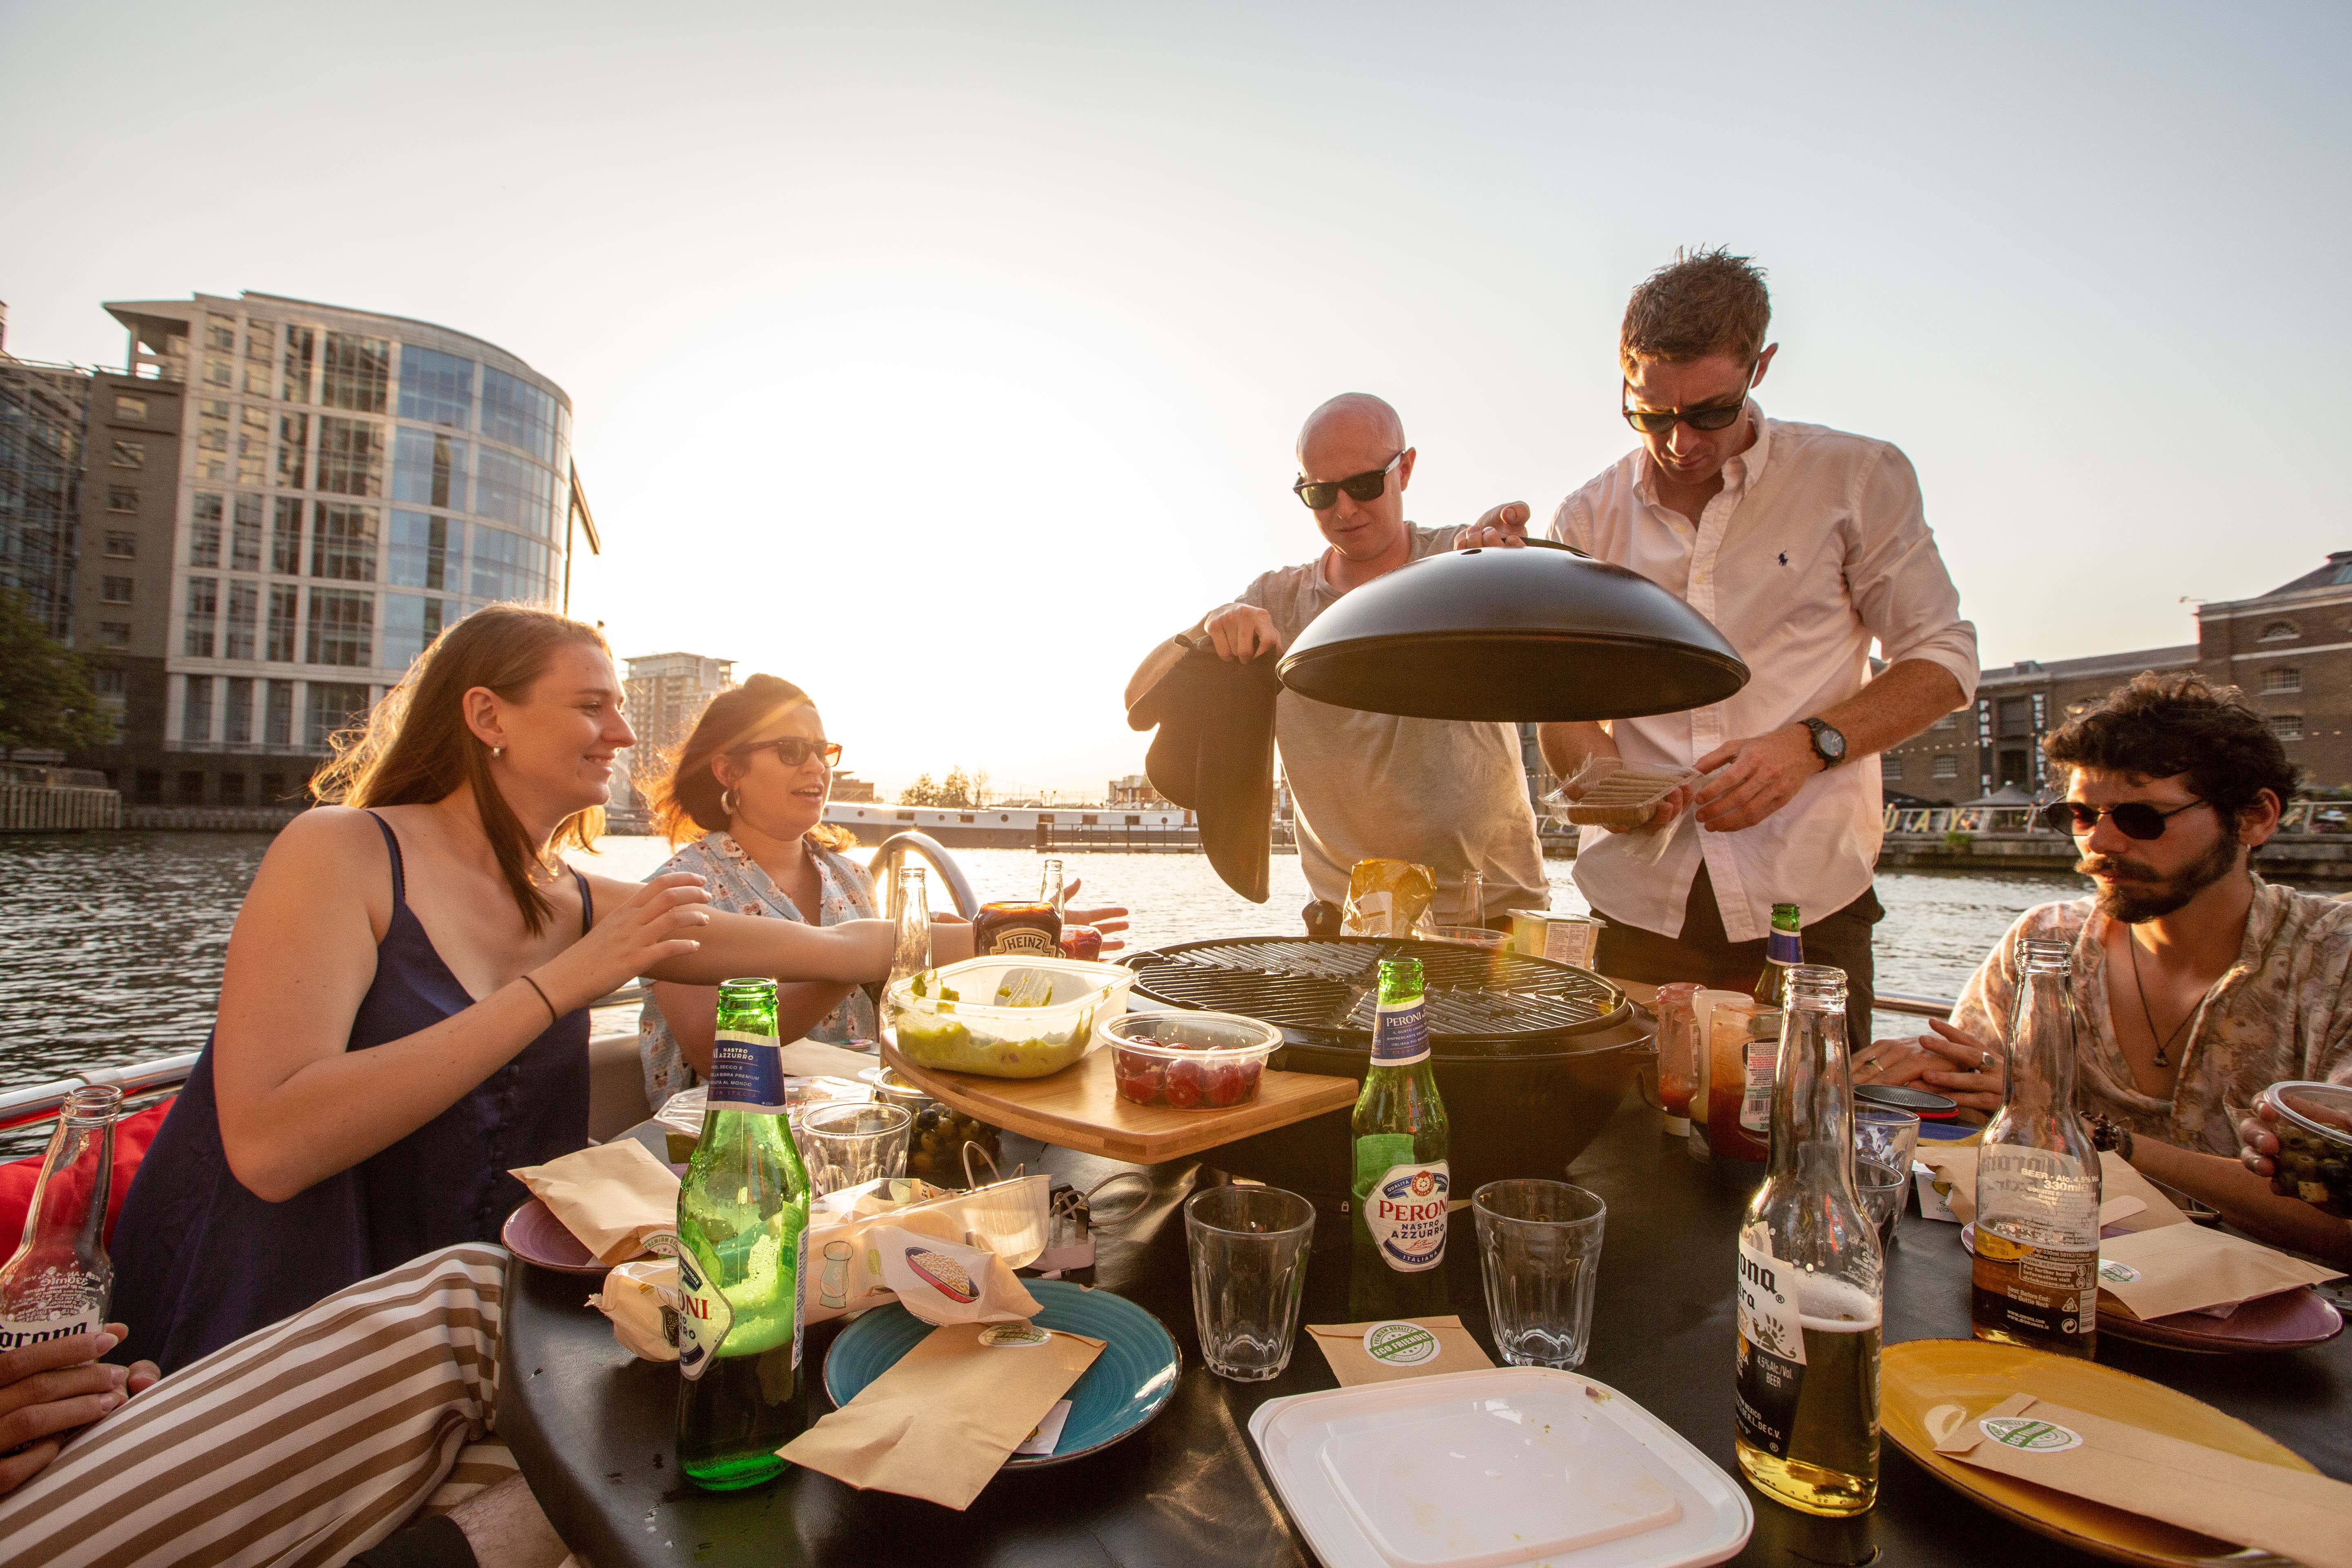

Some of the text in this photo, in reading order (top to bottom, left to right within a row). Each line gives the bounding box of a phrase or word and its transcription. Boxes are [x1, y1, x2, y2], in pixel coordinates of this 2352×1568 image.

[1979, 699, 1991, 748] PORT
[1883, 807, 1967, 833] UAY
[1007, 936, 1043, 950] HEINZ
[1386, 1012, 1421, 1027] PERONI
[2021, 1168, 2048, 1179] BEER
[2056, 1175, 2073, 1183] Alc.
[1387, 1179, 1409, 1192] QUALITÀ
[2044, 1180, 2082, 1192] 330ml
[1391, 1224, 1444, 1239] AZZURRO
[1402, 1219, 1439, 1230] NASTRO
[644, 1237, 669, 1248] PREMIUM
[1403, 1251, 1437, 1262] ITALIANA
[681, 1259, 700, 1286] SUPERIORE
[1740, 1253, 1777, 1294] ona
[2034, 1267, 2054, 1275] further
[2023, 1276, 2074, 1288] drinkaware.co.uk
[1739, 1281, 1755, 1310] tra
[2007, 1285, 2019, 1294] Best
[2020, 1290, 2038, 1300] Before
[2007, 1292, 2049, 1308] See Bottle Neck
[678, 1289, 710, 1320] ONI
[2007, 1309, 2045, 1324] www.corona.com
[2007, 1314, 2050, 1330] www.drinkaware.ie
[0, 1321, 88, 1348] orona
[1374, 1328, 1389, 1344] PREMIUM
[1374, 1332, 1430, 1356] ECO FRIENDLY
[1766, 1372, 1781, 1388] BEER
[1745, 1402, 1761, 1420] MEXICO
[1758, 1419, 1766, 1433] DE
[1768, 1426, 1781, 1440] C.V.
